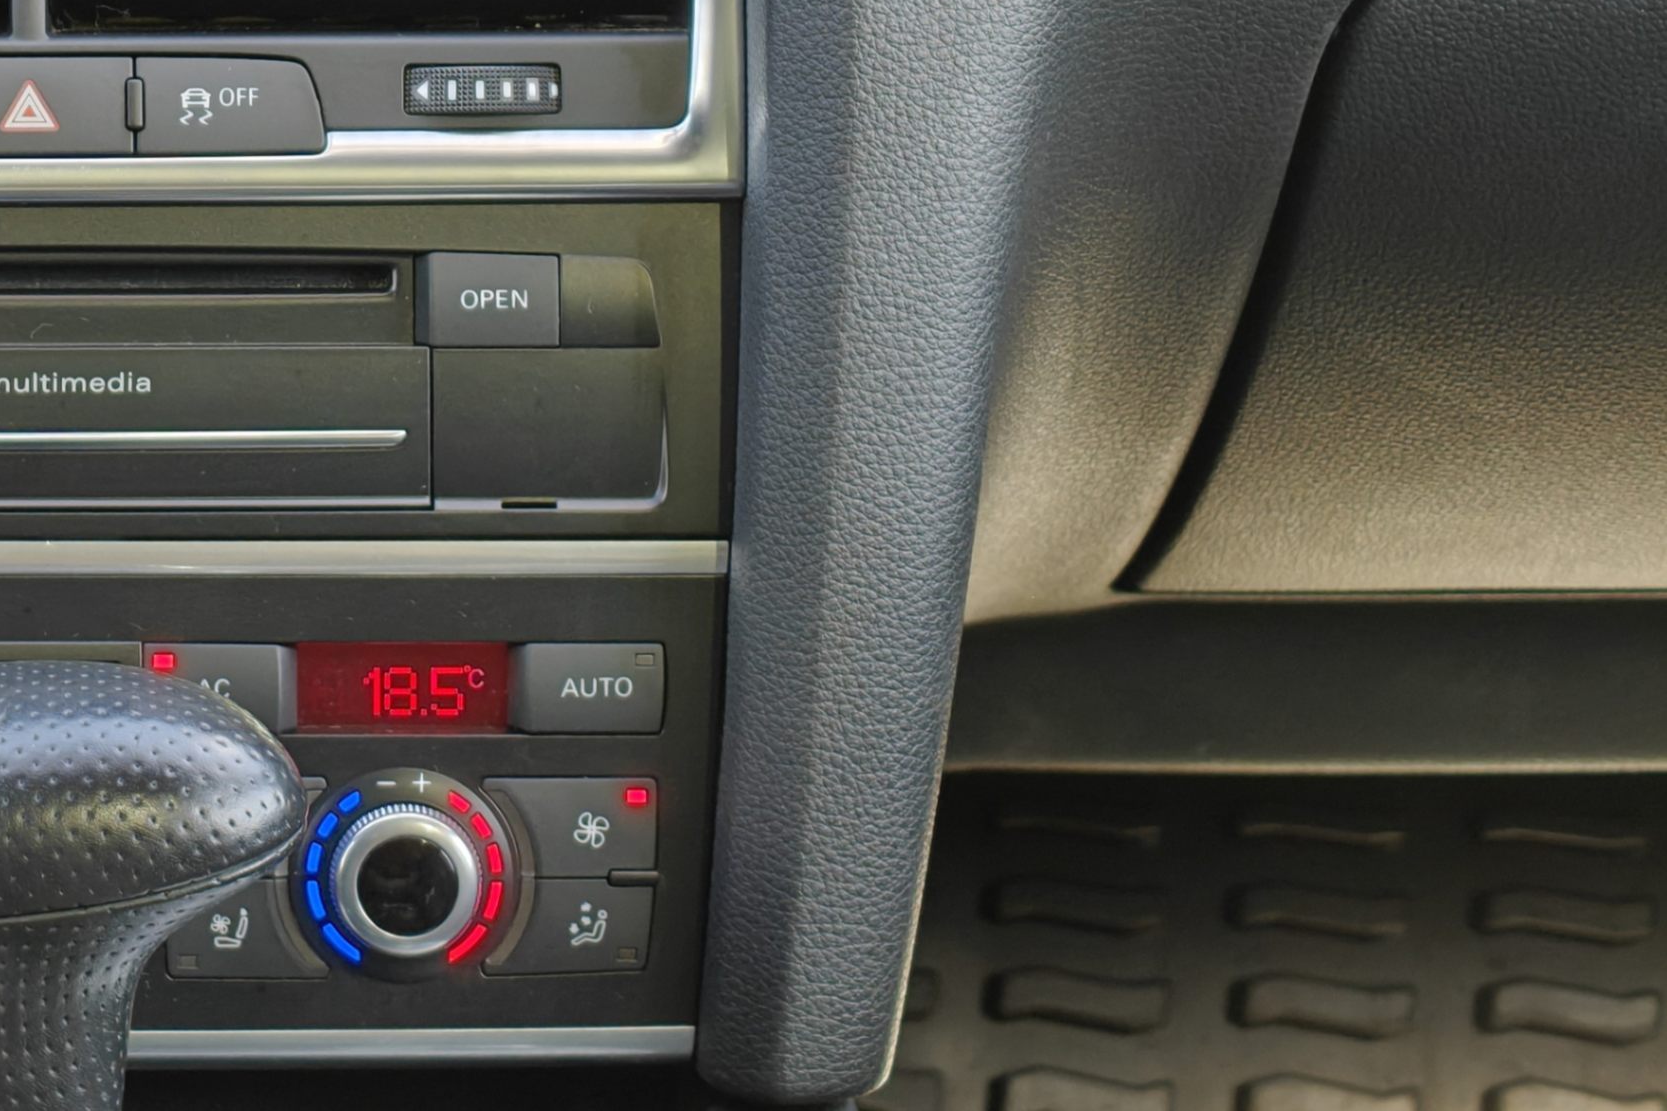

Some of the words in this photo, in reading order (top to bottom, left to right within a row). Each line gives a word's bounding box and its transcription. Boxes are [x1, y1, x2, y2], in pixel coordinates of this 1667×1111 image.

[218, 87, 260, 107] OFF
[460, 289, 529, 310] OPEN
[560, 676, 634, 699] AUTO
